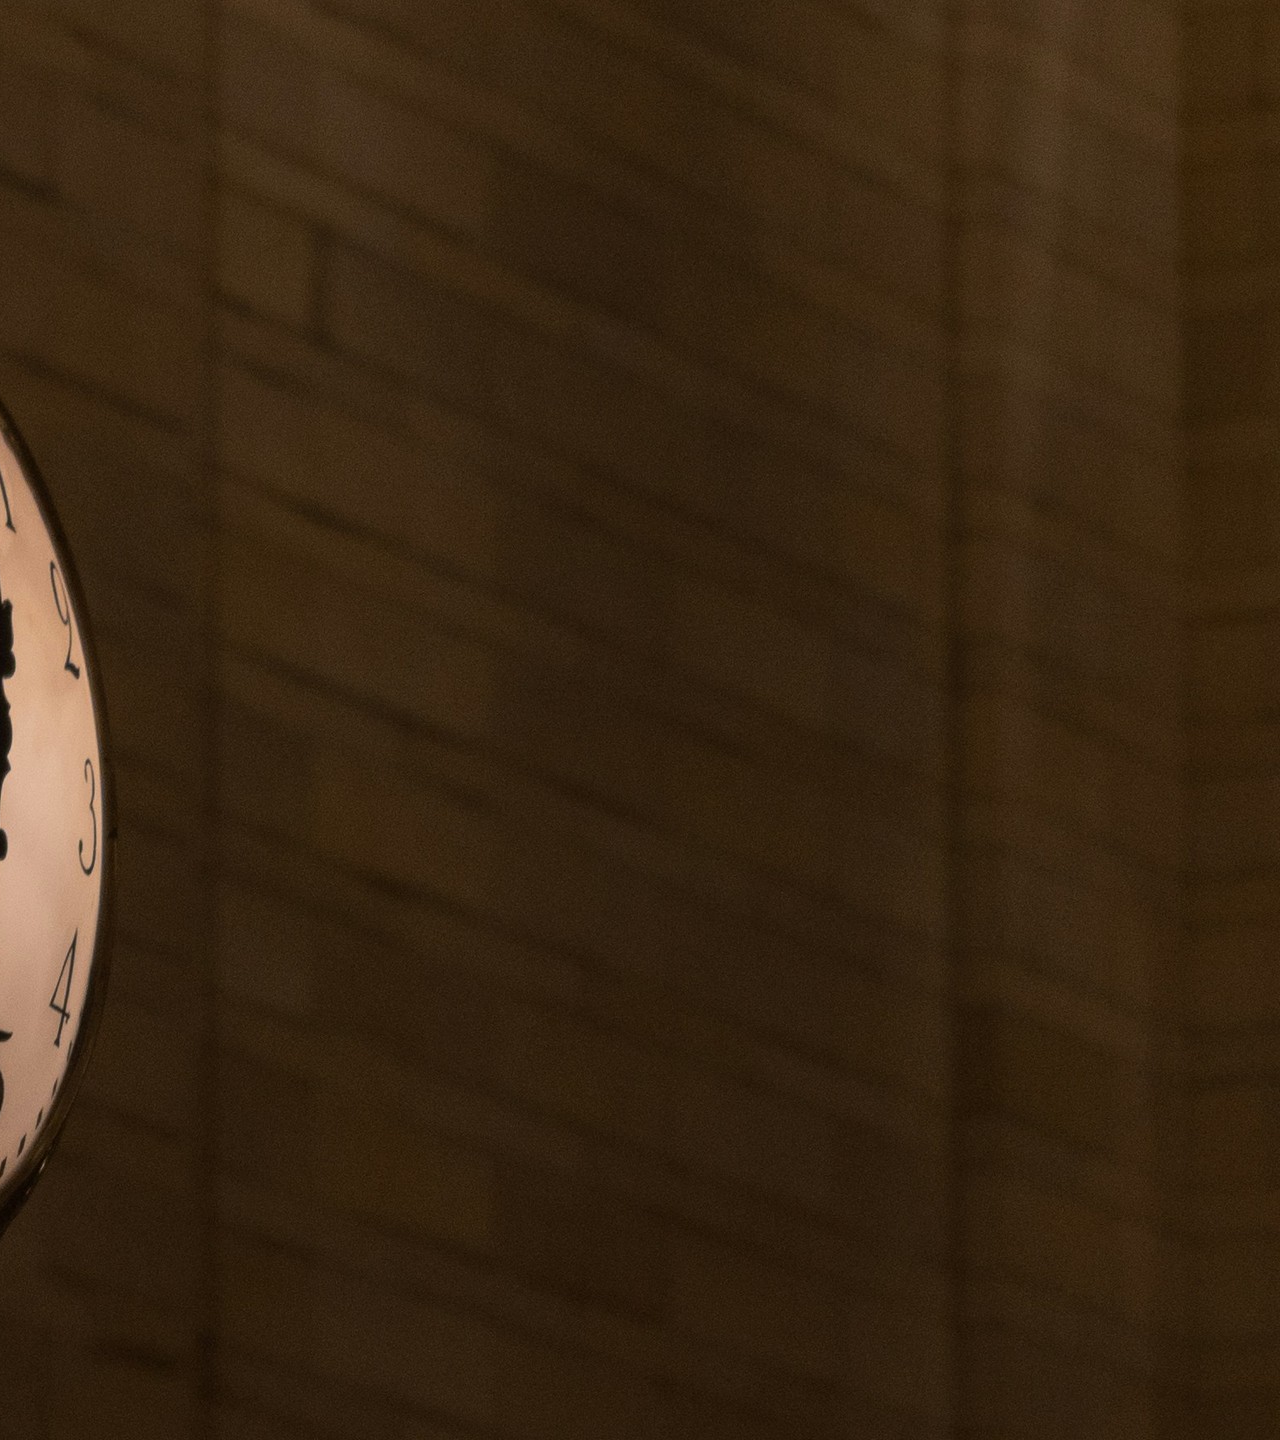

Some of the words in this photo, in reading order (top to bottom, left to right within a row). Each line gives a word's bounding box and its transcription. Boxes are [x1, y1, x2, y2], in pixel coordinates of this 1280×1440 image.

[49, 559, 82, 679] 2
[78, 758, 98, 876] 3
[49, 927, 78, 1049] 4
